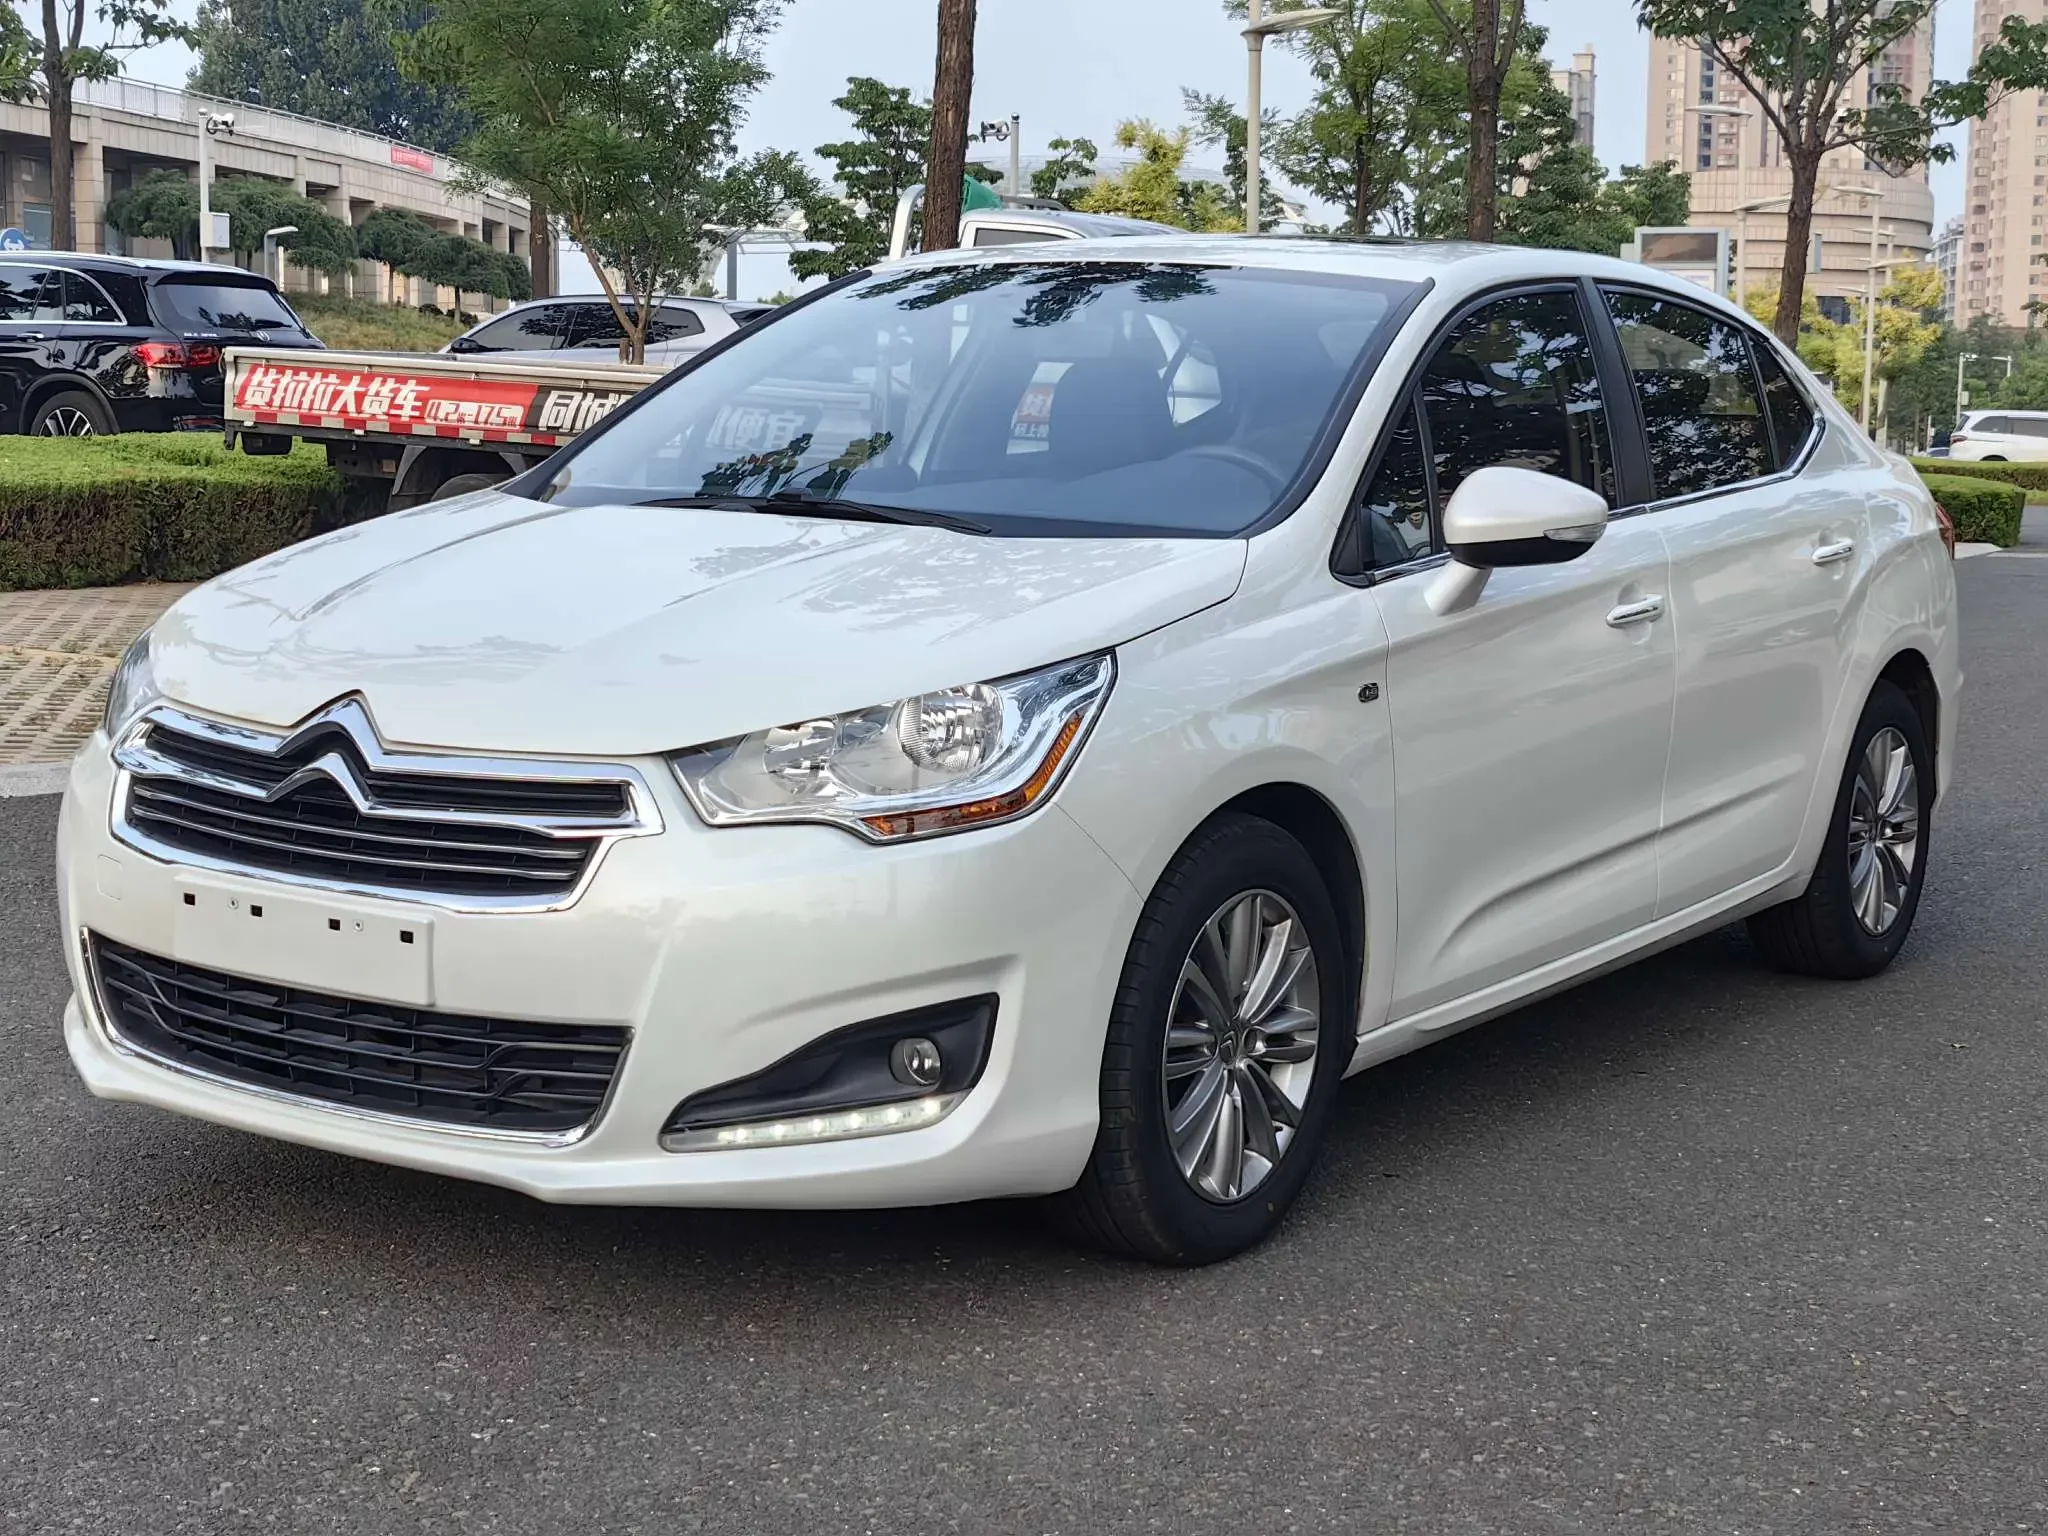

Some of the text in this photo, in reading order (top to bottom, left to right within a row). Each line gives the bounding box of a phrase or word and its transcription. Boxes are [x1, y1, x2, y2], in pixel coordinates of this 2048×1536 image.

[243, 367, 431, 420] 货拉拉大货车
